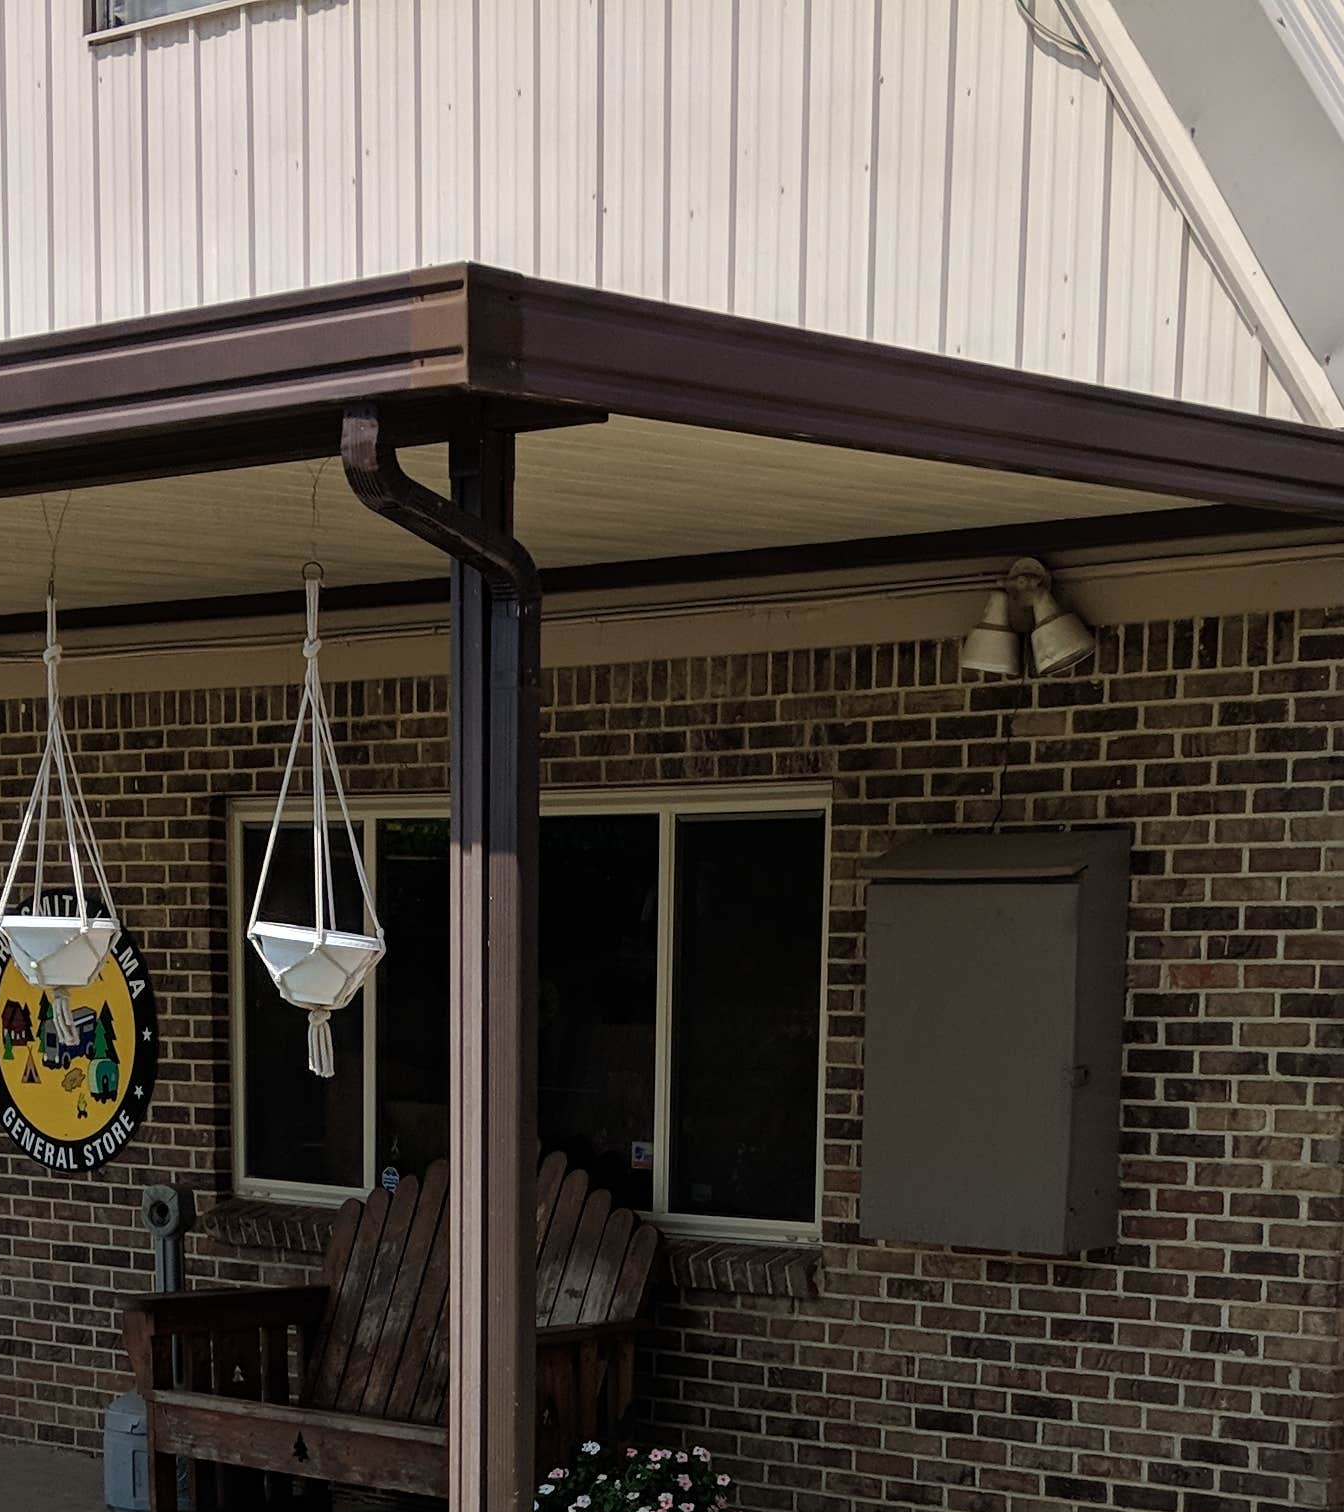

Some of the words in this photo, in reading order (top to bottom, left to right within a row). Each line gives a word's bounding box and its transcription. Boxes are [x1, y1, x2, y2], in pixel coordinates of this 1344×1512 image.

[110, 931, 146, 999] LMA
[2, 1106, 79, 1170] GENERAL
[83, 1109, 135, 1167] STORE
